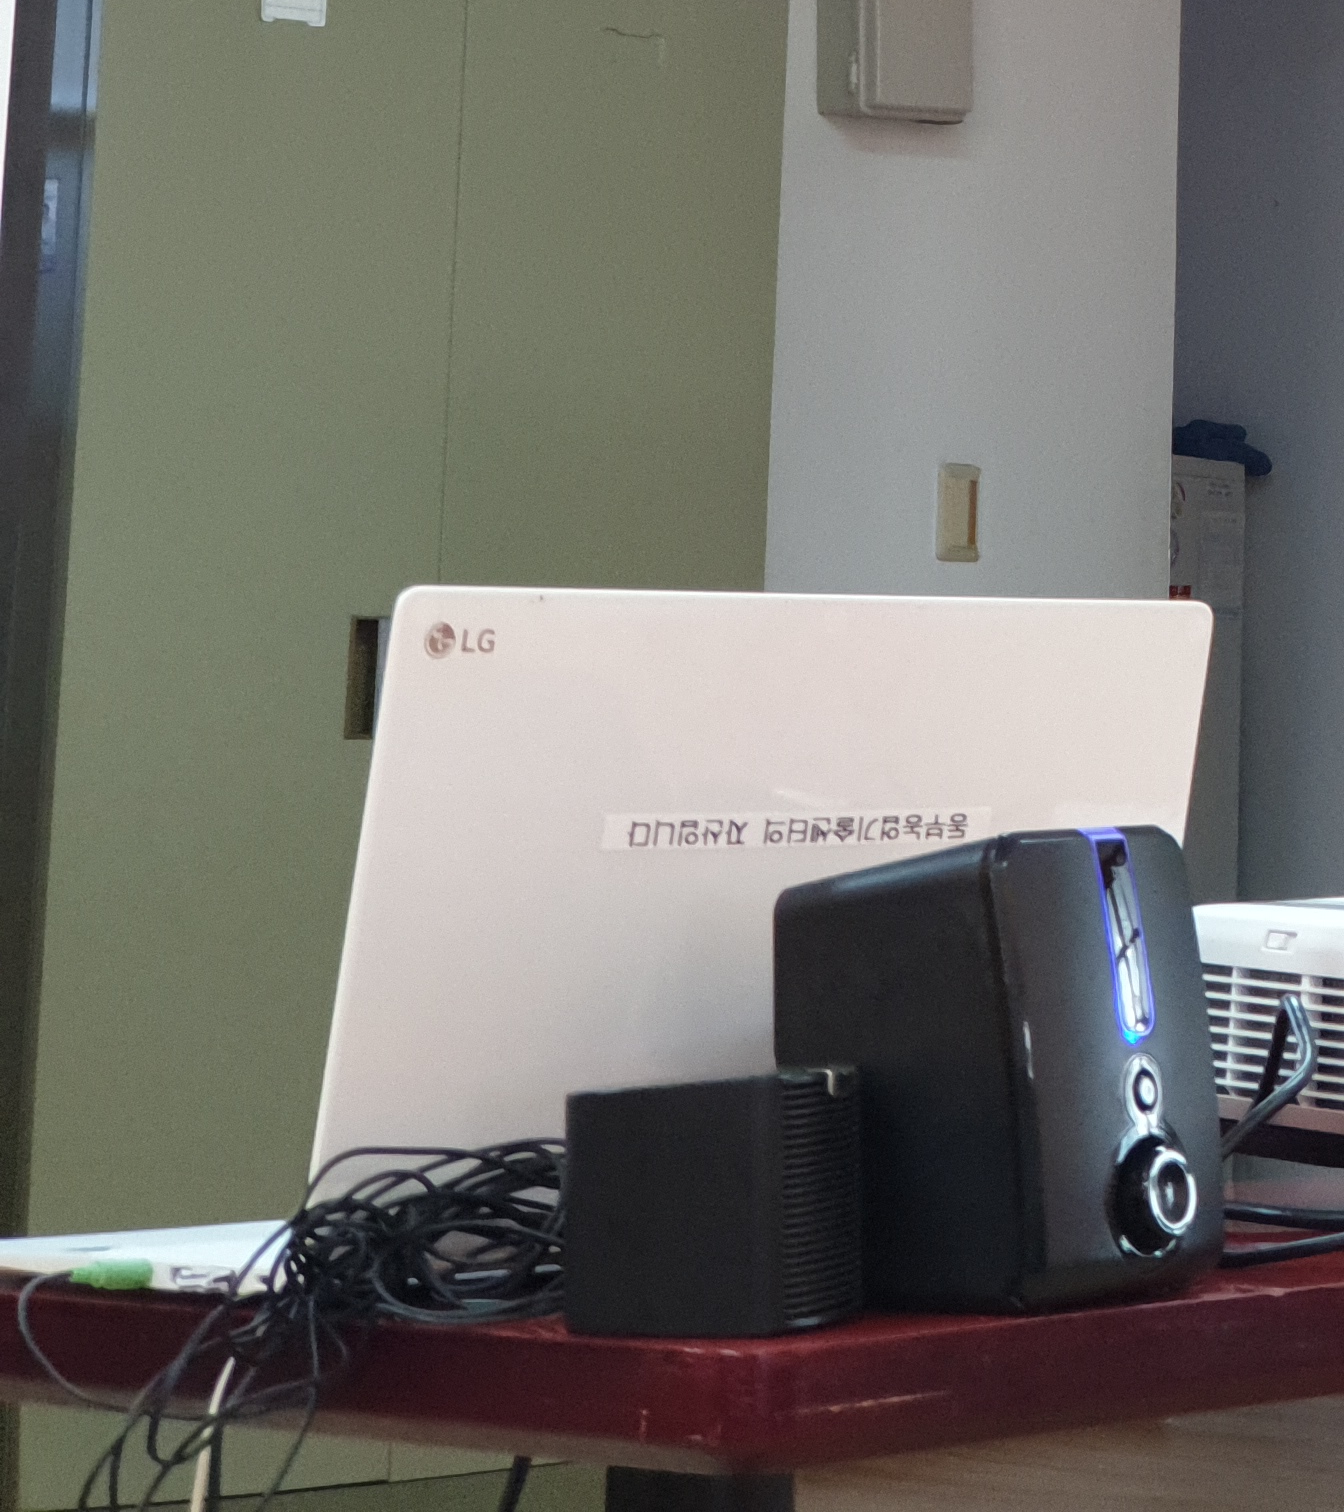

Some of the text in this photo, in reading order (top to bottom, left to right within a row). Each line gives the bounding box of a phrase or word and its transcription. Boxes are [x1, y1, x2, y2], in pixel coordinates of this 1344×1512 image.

[461, 628, 496, 653] LG
[627, 812, 969, 848] 동부농업기술센터의 자산입니다
